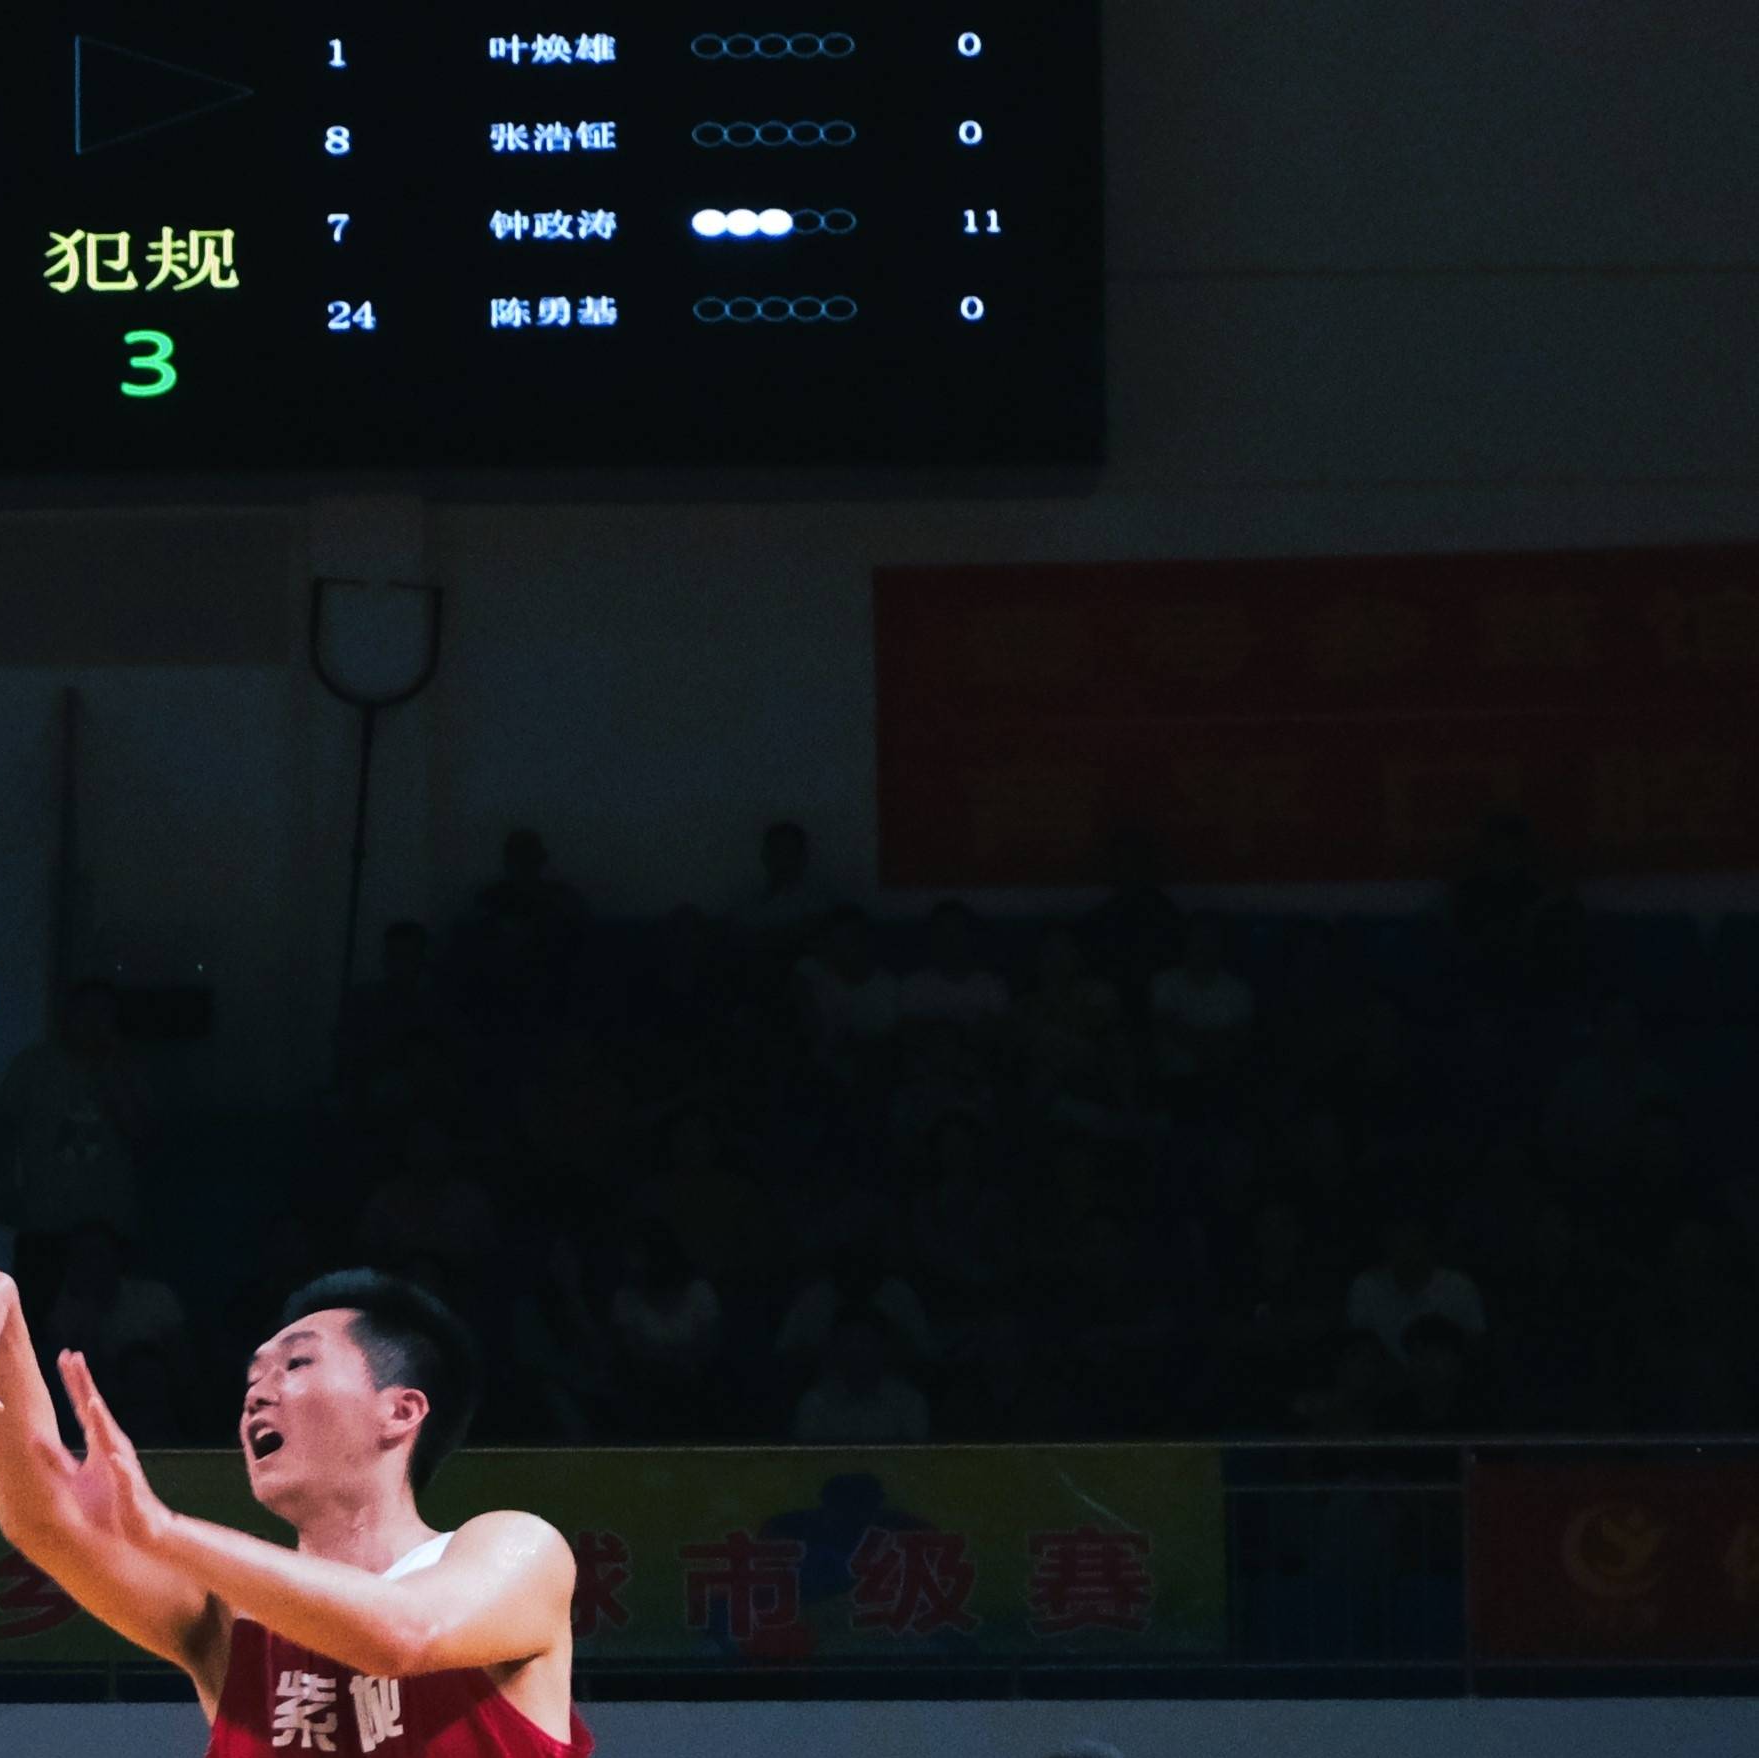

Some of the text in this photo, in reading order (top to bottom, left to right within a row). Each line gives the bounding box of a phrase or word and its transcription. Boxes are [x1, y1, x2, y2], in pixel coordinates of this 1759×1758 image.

[329, 39, 346, 68] 1
[958, 32, 981, 57] 0
[325, 126, 350, 155] 8
[959, 120, 982, 145] 0
[328, 214, 349, 242] 7
[964, 209, 1001, 234] 11
[44, 226, 239, 293] 犯规
[328, 301, 376, 331] 24
[960, 296, 984, 321] 0
[121, 330, 177, 397] 3
